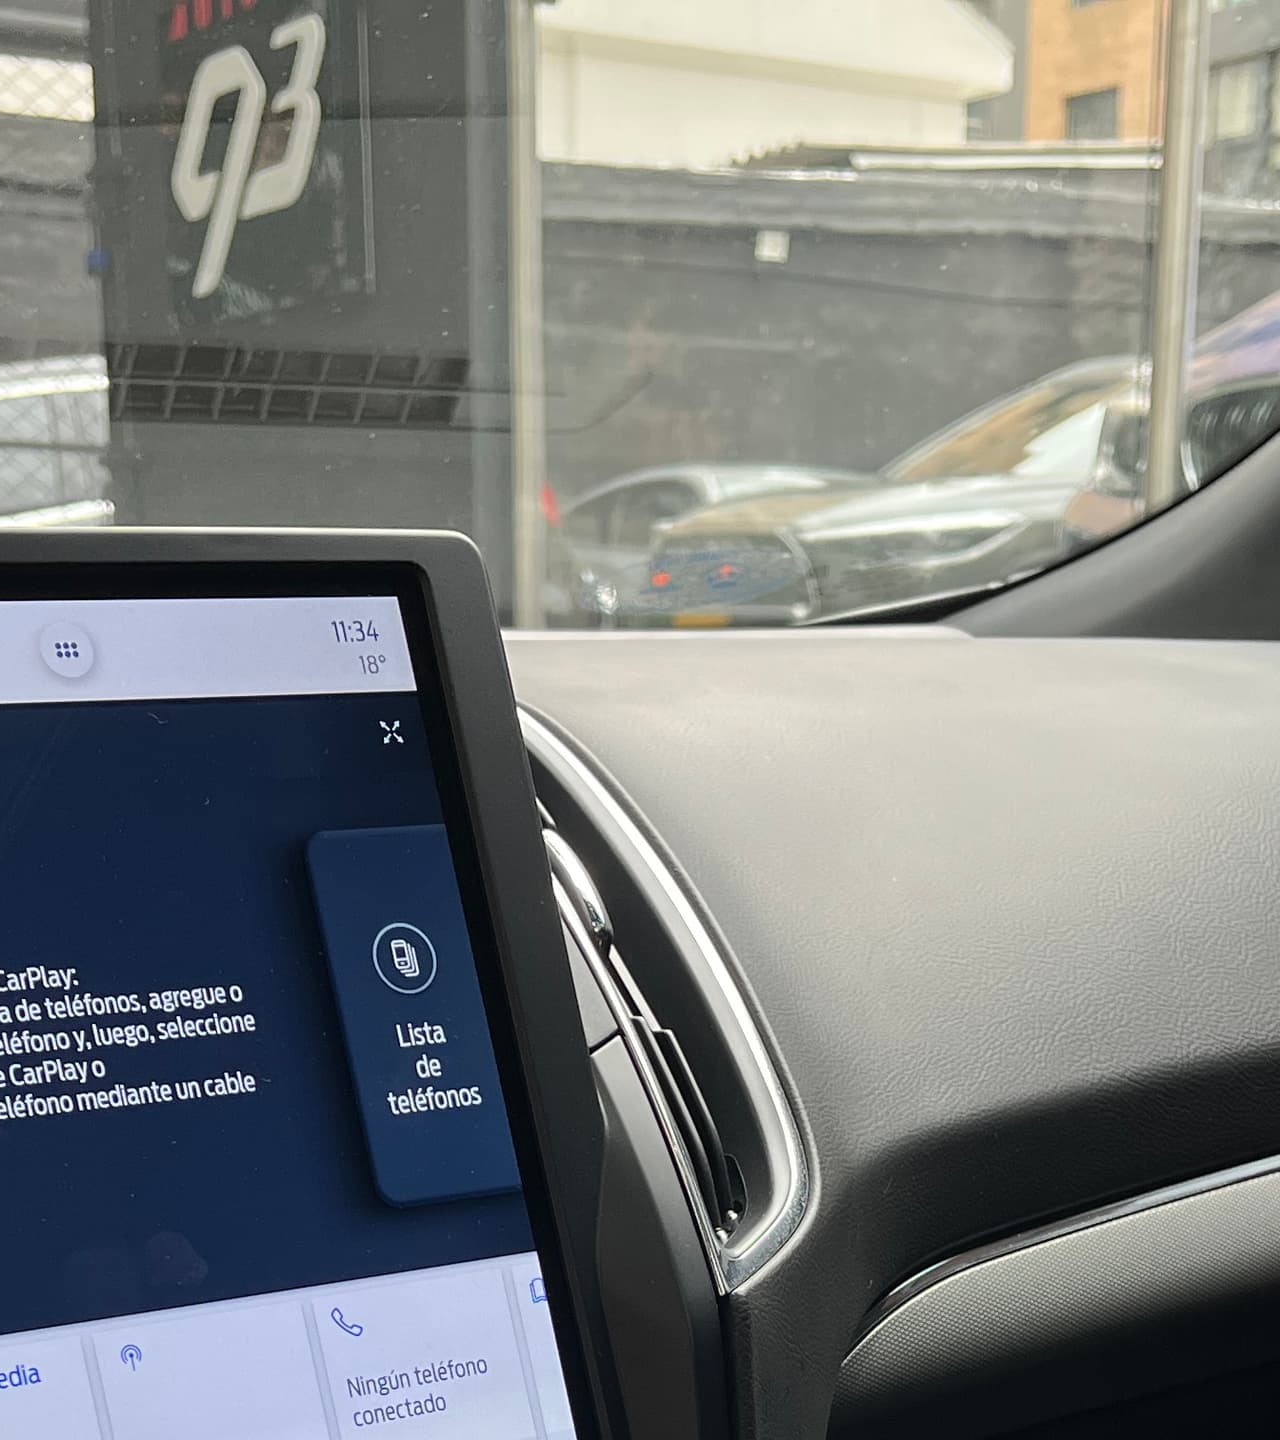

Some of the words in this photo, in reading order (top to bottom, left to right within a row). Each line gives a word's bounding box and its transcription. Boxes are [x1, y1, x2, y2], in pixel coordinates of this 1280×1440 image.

[171, 13, 326, 299] 93
[330, 620, 380, 643] 11:34
[358, 654, 387, 675] 18°
[14, 998, 42, 1022] de
[43, 992, 147, 1020] teléfonos,
[148, 986, 227, 1013] agregue
[229, 985, 243, 1003] o
[71, 1030, 92, 1052] y,
[91, 1023, 156, 1047] luego,
[156, 1012, 256, 1040] seleccione
[395, 1021, 447, 1048] Lista
[8, 1058, 88, 1086] CarPlay
[91, 1060, 106, 1078] o
[415, 1053, 442, 1079] de
[75, 1081, 173, 1112] mediante
[174, 1080, 202, 1100] un
[203, 1070, 257, 1097] cable
[386, 1086, 482, 1115] teléfonos
[346, 1369, 411, 1398] Ningún
[413, 1358, 488, 1386] teléfono
[353, 1393, 447, 1427] conectado
